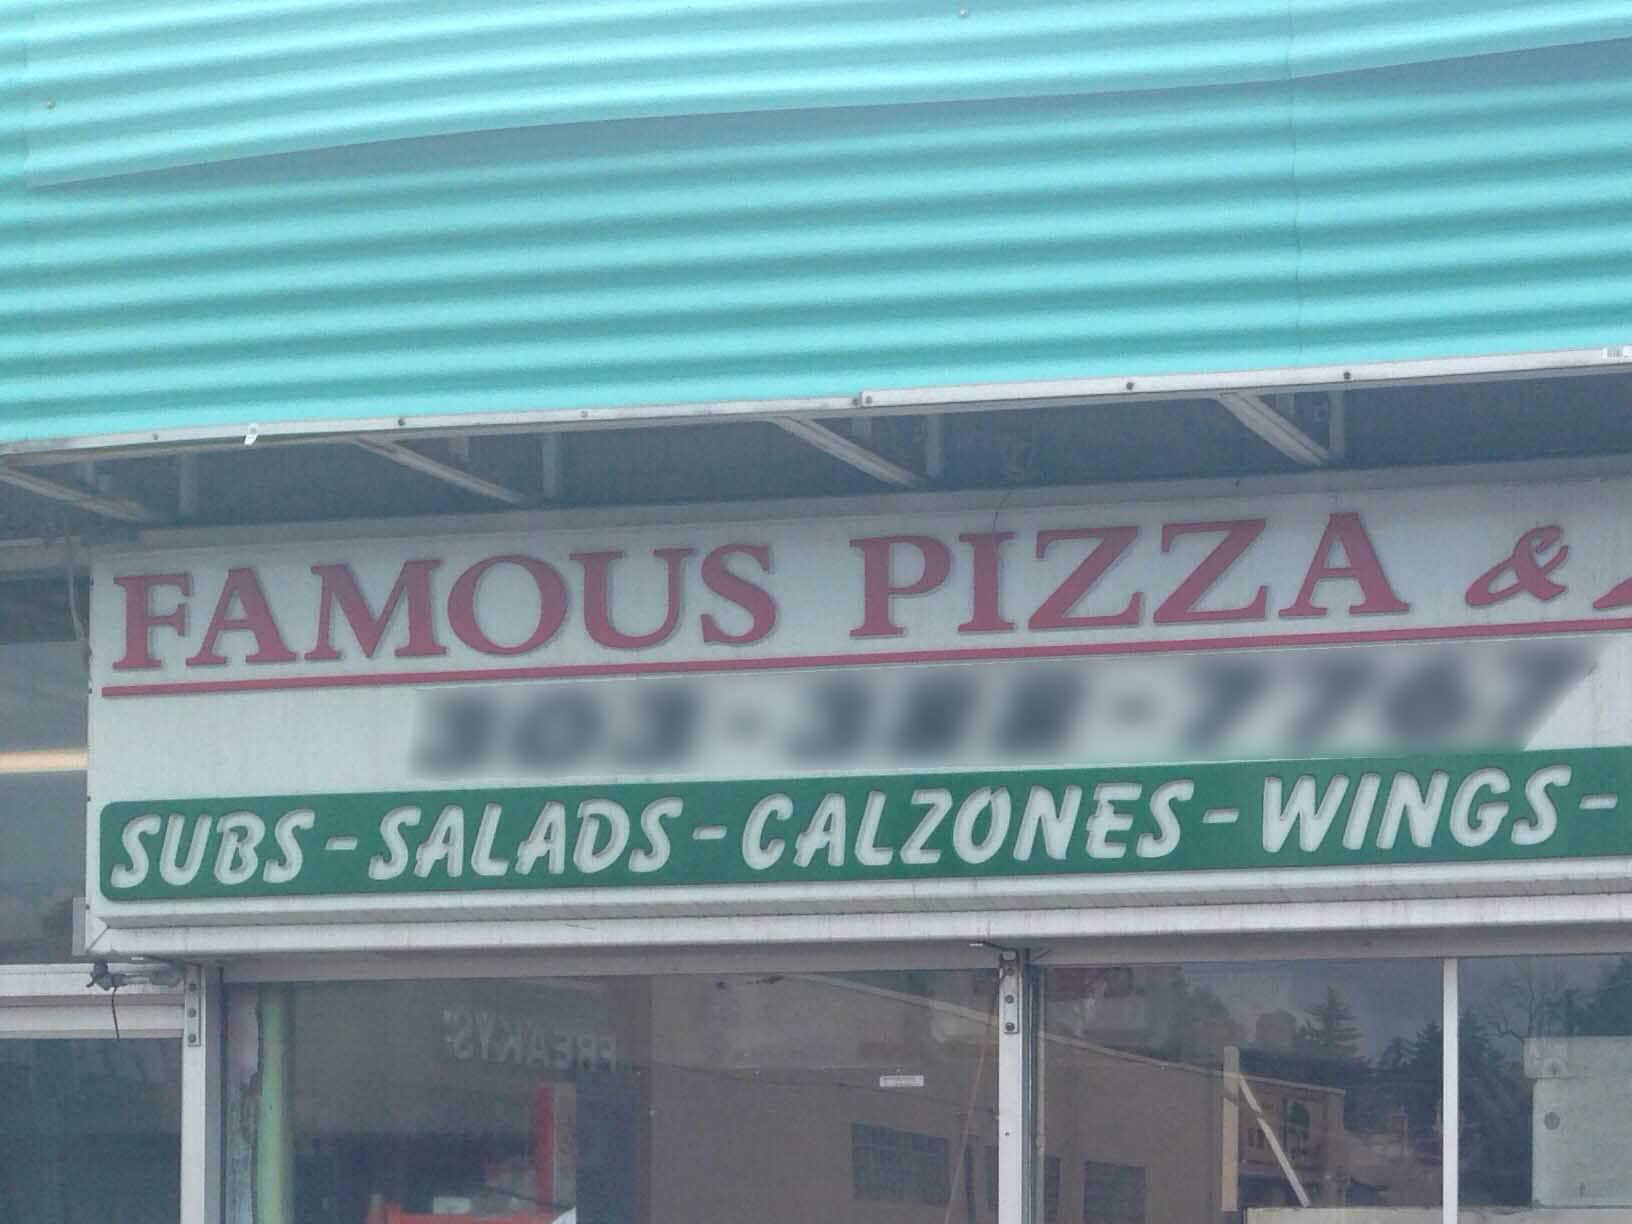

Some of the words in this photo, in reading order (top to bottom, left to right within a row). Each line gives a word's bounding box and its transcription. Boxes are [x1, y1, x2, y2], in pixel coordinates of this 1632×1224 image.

[112, 542, 778, 671] FAMOUS
[848, 511, 1410, 640] PIZZA
[1465, 524, 1570, 607] &
[110, 810, 315, 889] SUBS
[368, 798, 683, 881] SALADS
[741, 779, 1196, 871] CALZONES
[1261, 766, 1572, 854] WINGS
